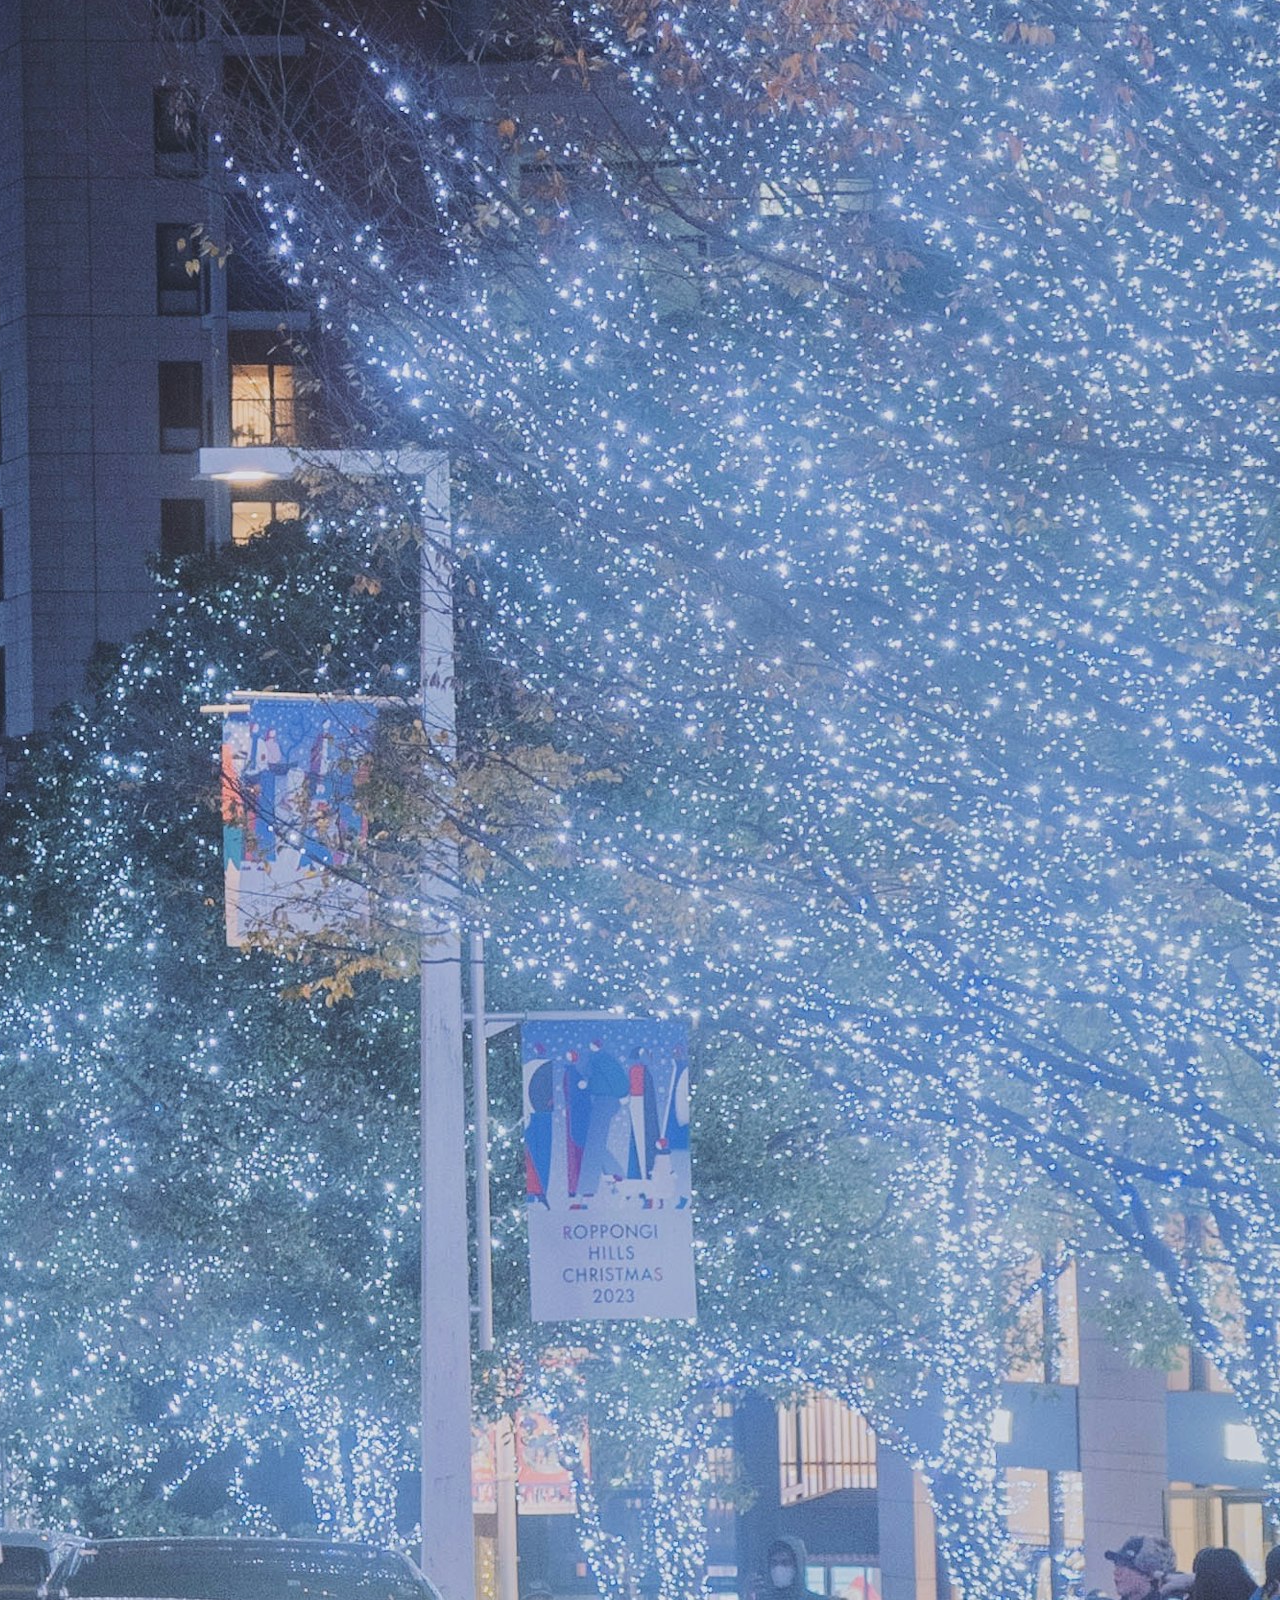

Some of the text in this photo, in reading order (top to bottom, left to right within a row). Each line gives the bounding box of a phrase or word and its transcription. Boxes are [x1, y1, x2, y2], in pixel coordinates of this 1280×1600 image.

[562, 1224, 658, 1240] ROPPONGI
[588, 1246, 635, 1260] HILLS
[562, 1267, 664, 1283] CHRISTMAS
[592, 1288, 635, 1304] 2023
